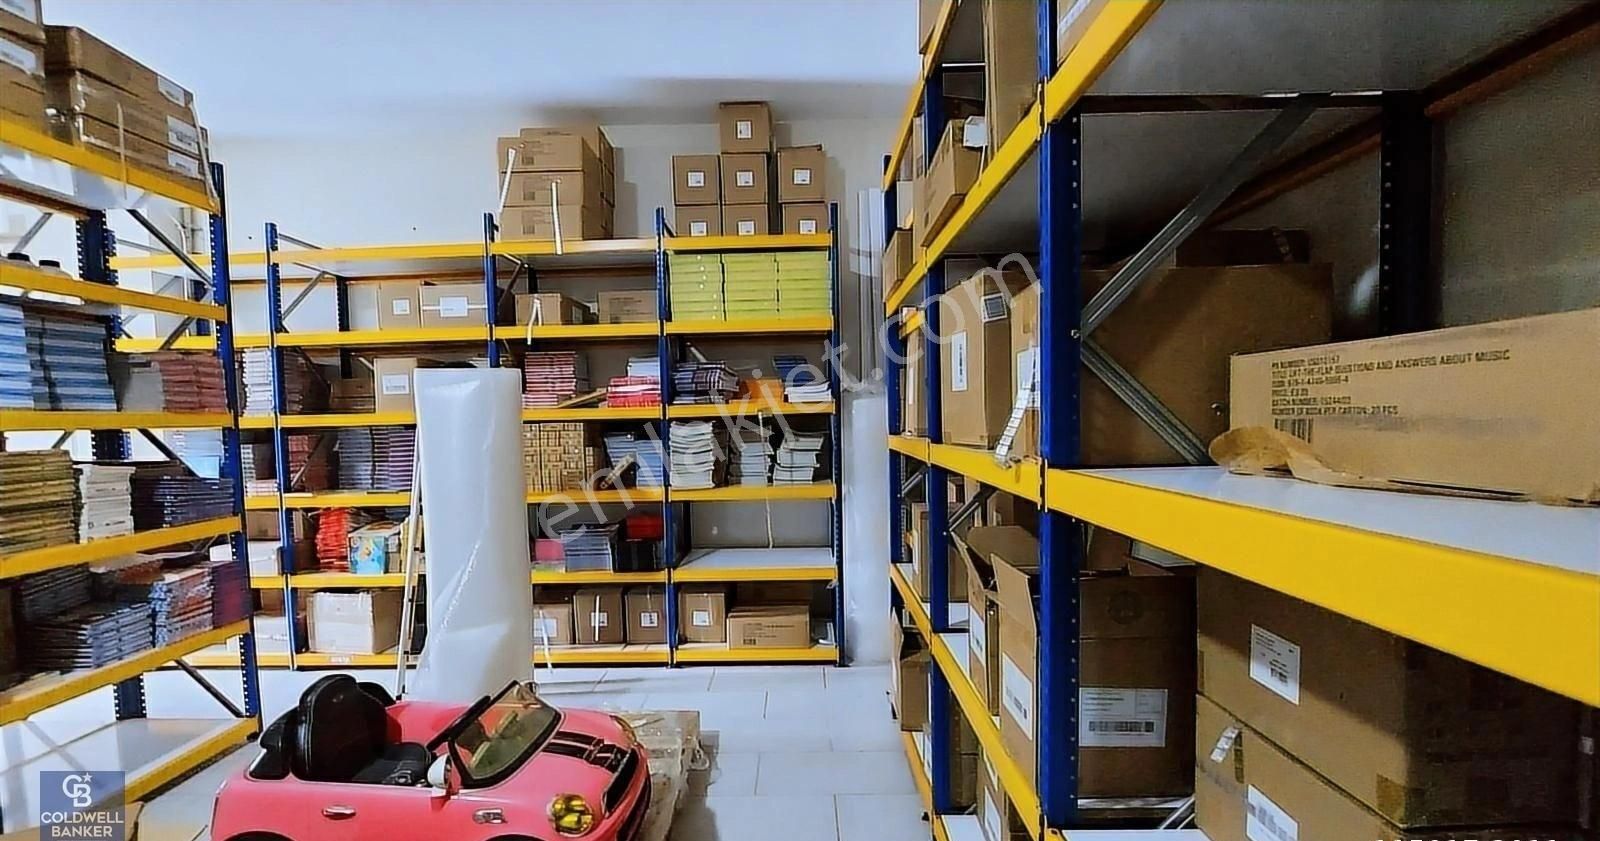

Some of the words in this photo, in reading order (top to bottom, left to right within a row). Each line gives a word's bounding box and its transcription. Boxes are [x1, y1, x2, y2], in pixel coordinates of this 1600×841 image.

[1335, 362, 1375, 375] QUESTIONS
[1376, 361, 1394, 370] AND
[1395, 357, 1437, 369] ANSWERS
[1439, 353, 1473, 366] ABOUT
[1475, 349, 1511, 363] MUSIC
